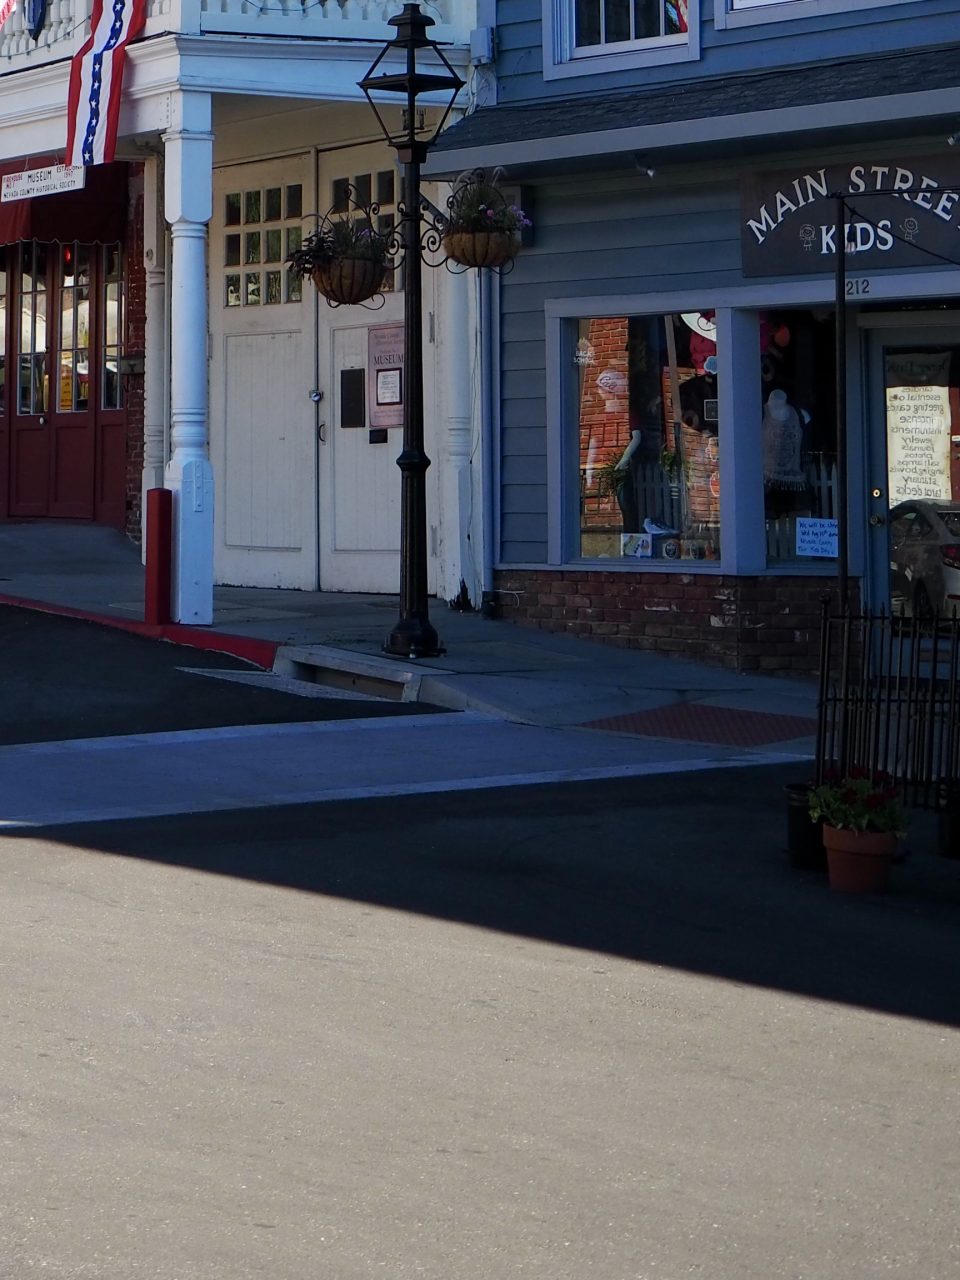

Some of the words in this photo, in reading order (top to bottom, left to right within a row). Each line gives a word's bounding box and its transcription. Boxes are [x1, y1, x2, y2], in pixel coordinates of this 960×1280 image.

[27, 169, 52, 183] MUSEUM
[3, 190, 19, 199] NEVADA
[20, 187, 35, 197] COUNTY
[36, 182, 58, 194] HISTORICAL
[60, 179, 76, 190] SOCIETY
[746, 168, 829, 245] MAIN
[848, 165, 960, 229] STREE
[846, 279, 870, 296] 212
[373, 353, 404, 366] MUSEUM
